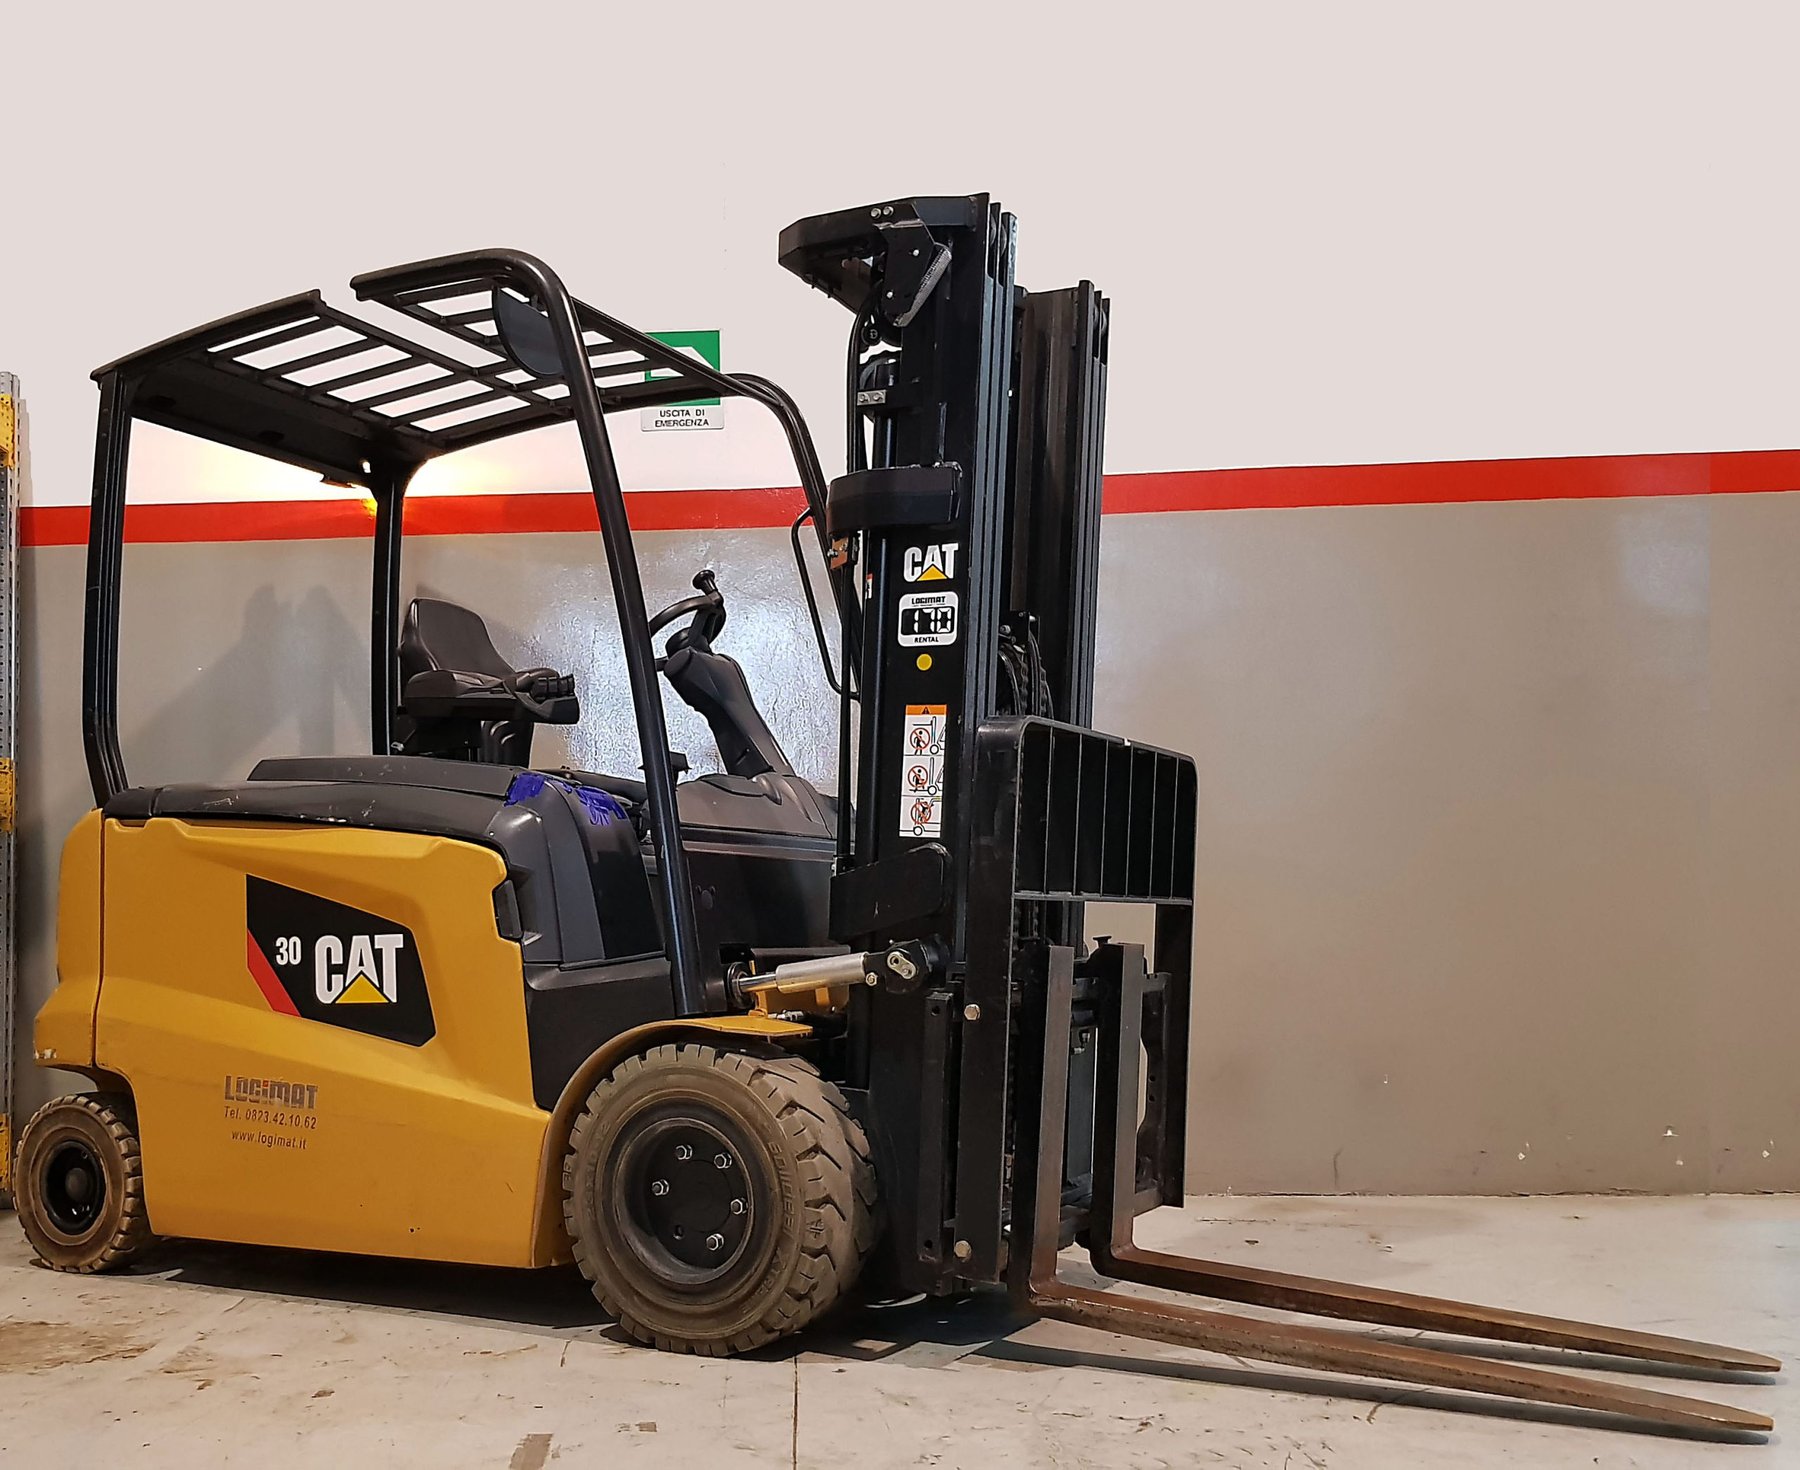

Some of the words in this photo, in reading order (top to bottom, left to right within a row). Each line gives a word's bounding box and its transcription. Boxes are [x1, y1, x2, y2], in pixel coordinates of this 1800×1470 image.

[655, 419, 709, 427] EMERGENZA
[660, 409, 691, 418] USCITA
[903, 543, 959, 582] CAT
[913, 607, 952, 633] 170
[275, 936, 302, 965] 30
[314, 933, 404, 1004] CAT
[224, 1106, 242, 1119] Tel.
[245, 1108, 317, 1130] 0823.42.10.62
[231, 1131, 307, 1149] www.logimat.it
